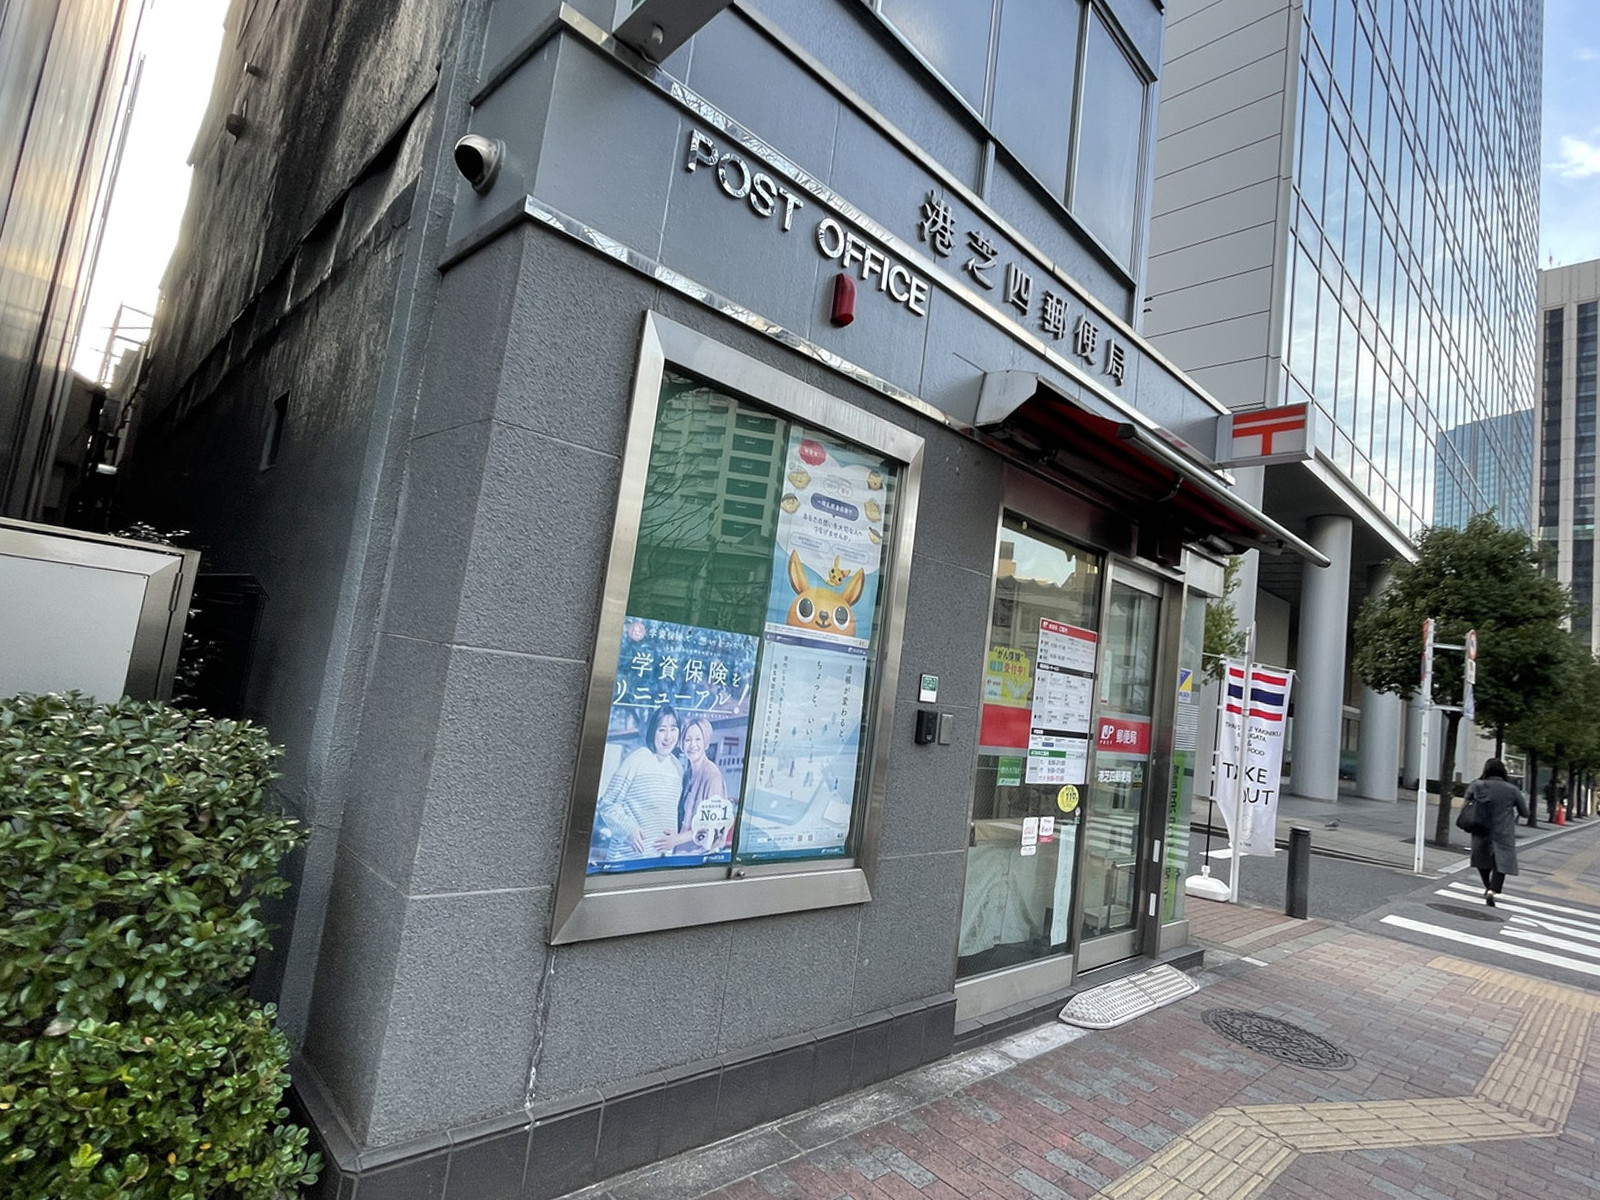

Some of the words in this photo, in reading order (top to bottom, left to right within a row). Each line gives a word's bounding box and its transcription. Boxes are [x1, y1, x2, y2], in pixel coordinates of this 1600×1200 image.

[687, 129, 803, 231] POST
[816, 218, 928, 316] OFFICE
[918, 190, 1125, 386] 港芝四郵便局
[630, 652, 742, 688] 学資保険を
[1116, 729, 1137, 745] 郵便局
[1242, 788, 1275, 805] UT
[700, 805, 728, 821] No.1
